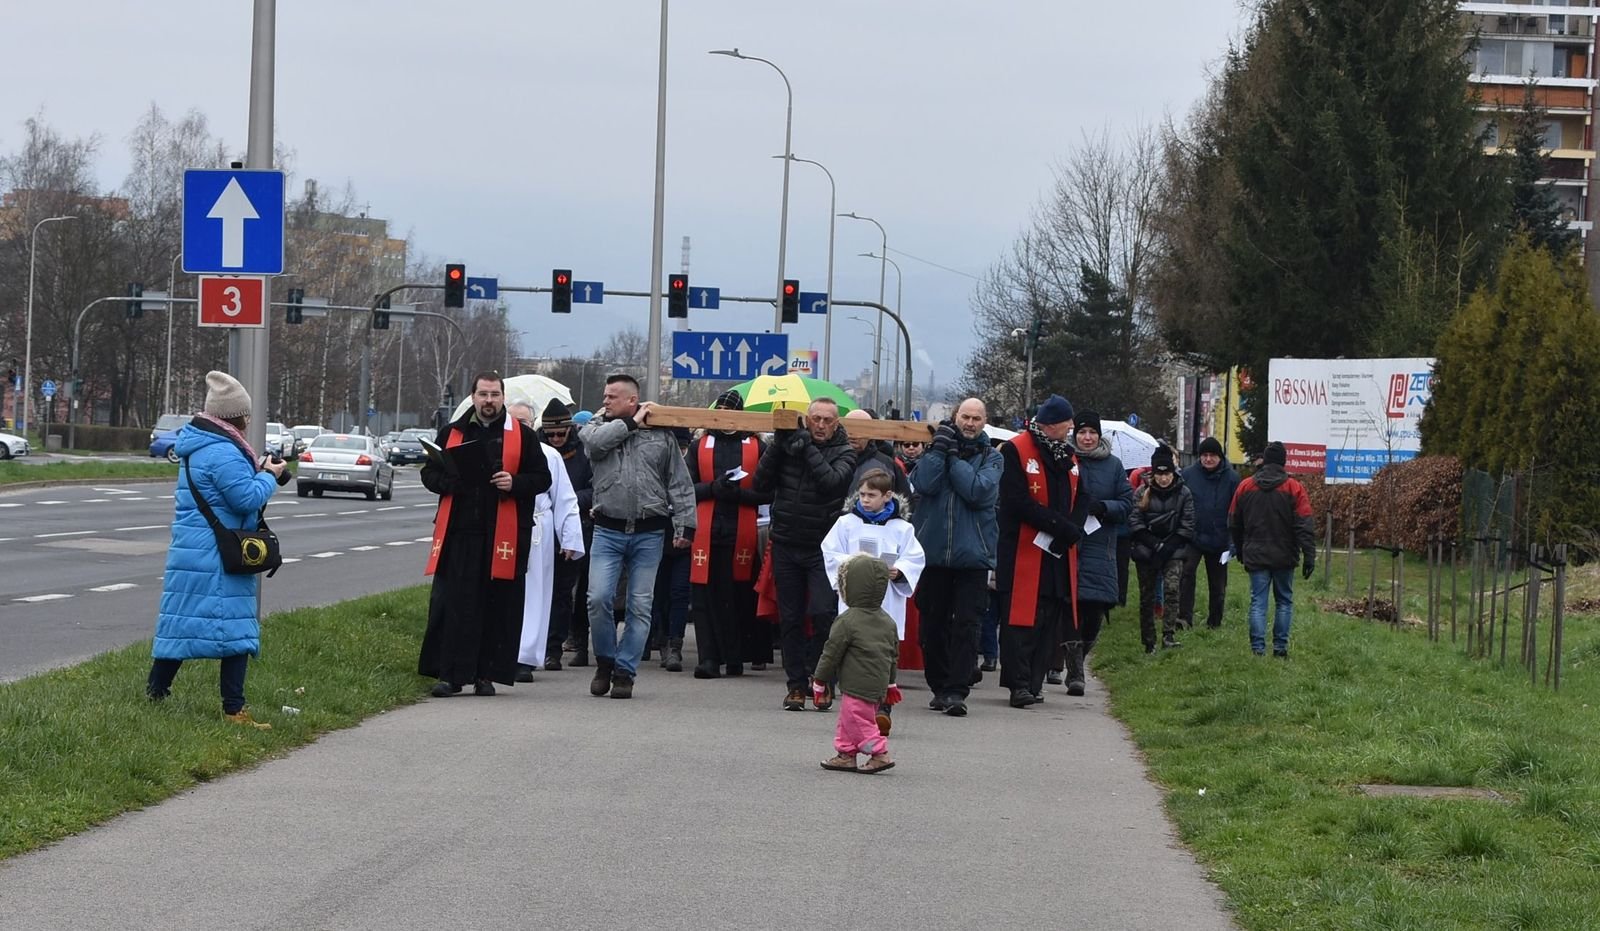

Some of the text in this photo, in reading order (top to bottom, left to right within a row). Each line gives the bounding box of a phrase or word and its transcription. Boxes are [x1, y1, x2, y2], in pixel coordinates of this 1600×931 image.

[221, 286, 242, 317] 3
[791, 357, 809, 368] dm
[1274, 378, 1328, 406] ROSSMA
